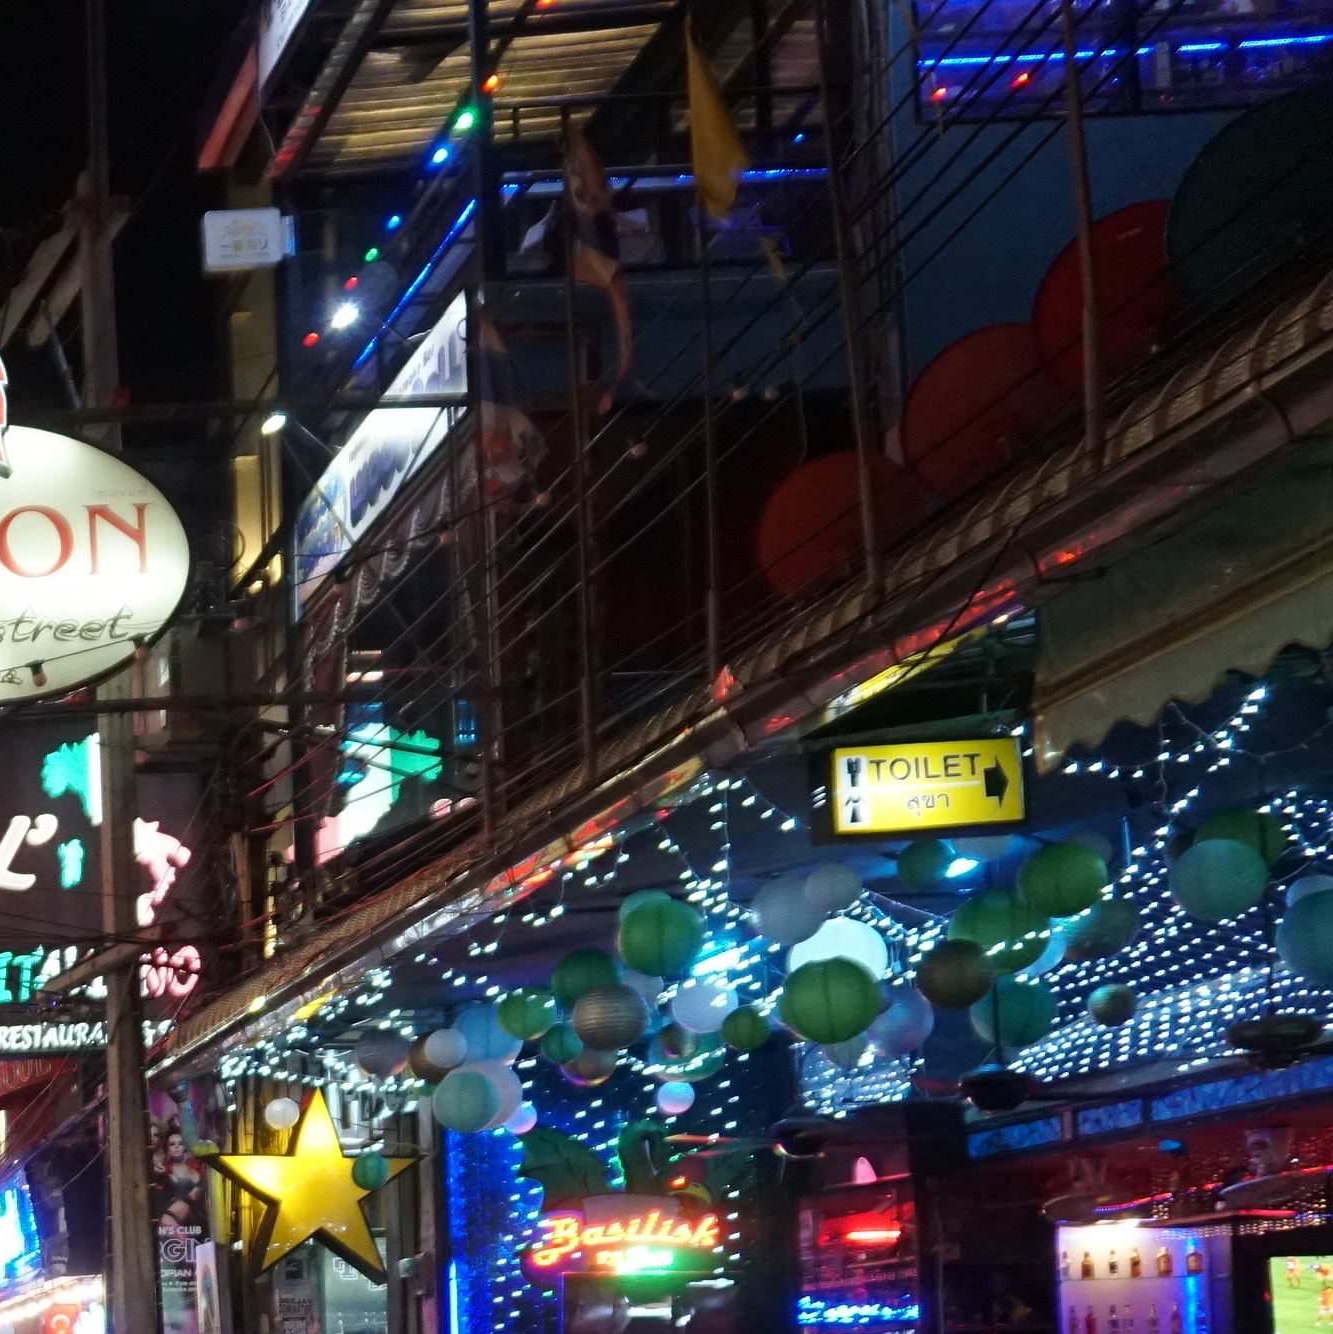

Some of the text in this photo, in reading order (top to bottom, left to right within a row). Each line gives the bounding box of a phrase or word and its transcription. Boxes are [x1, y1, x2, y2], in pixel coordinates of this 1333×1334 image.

[869, 752, 982, 782] TOILET
[906, 793, 950, 817] สุขา
[176, 1225, 202, 1235] CLUB
[532, 1208, 721, 1267] Basilisk
